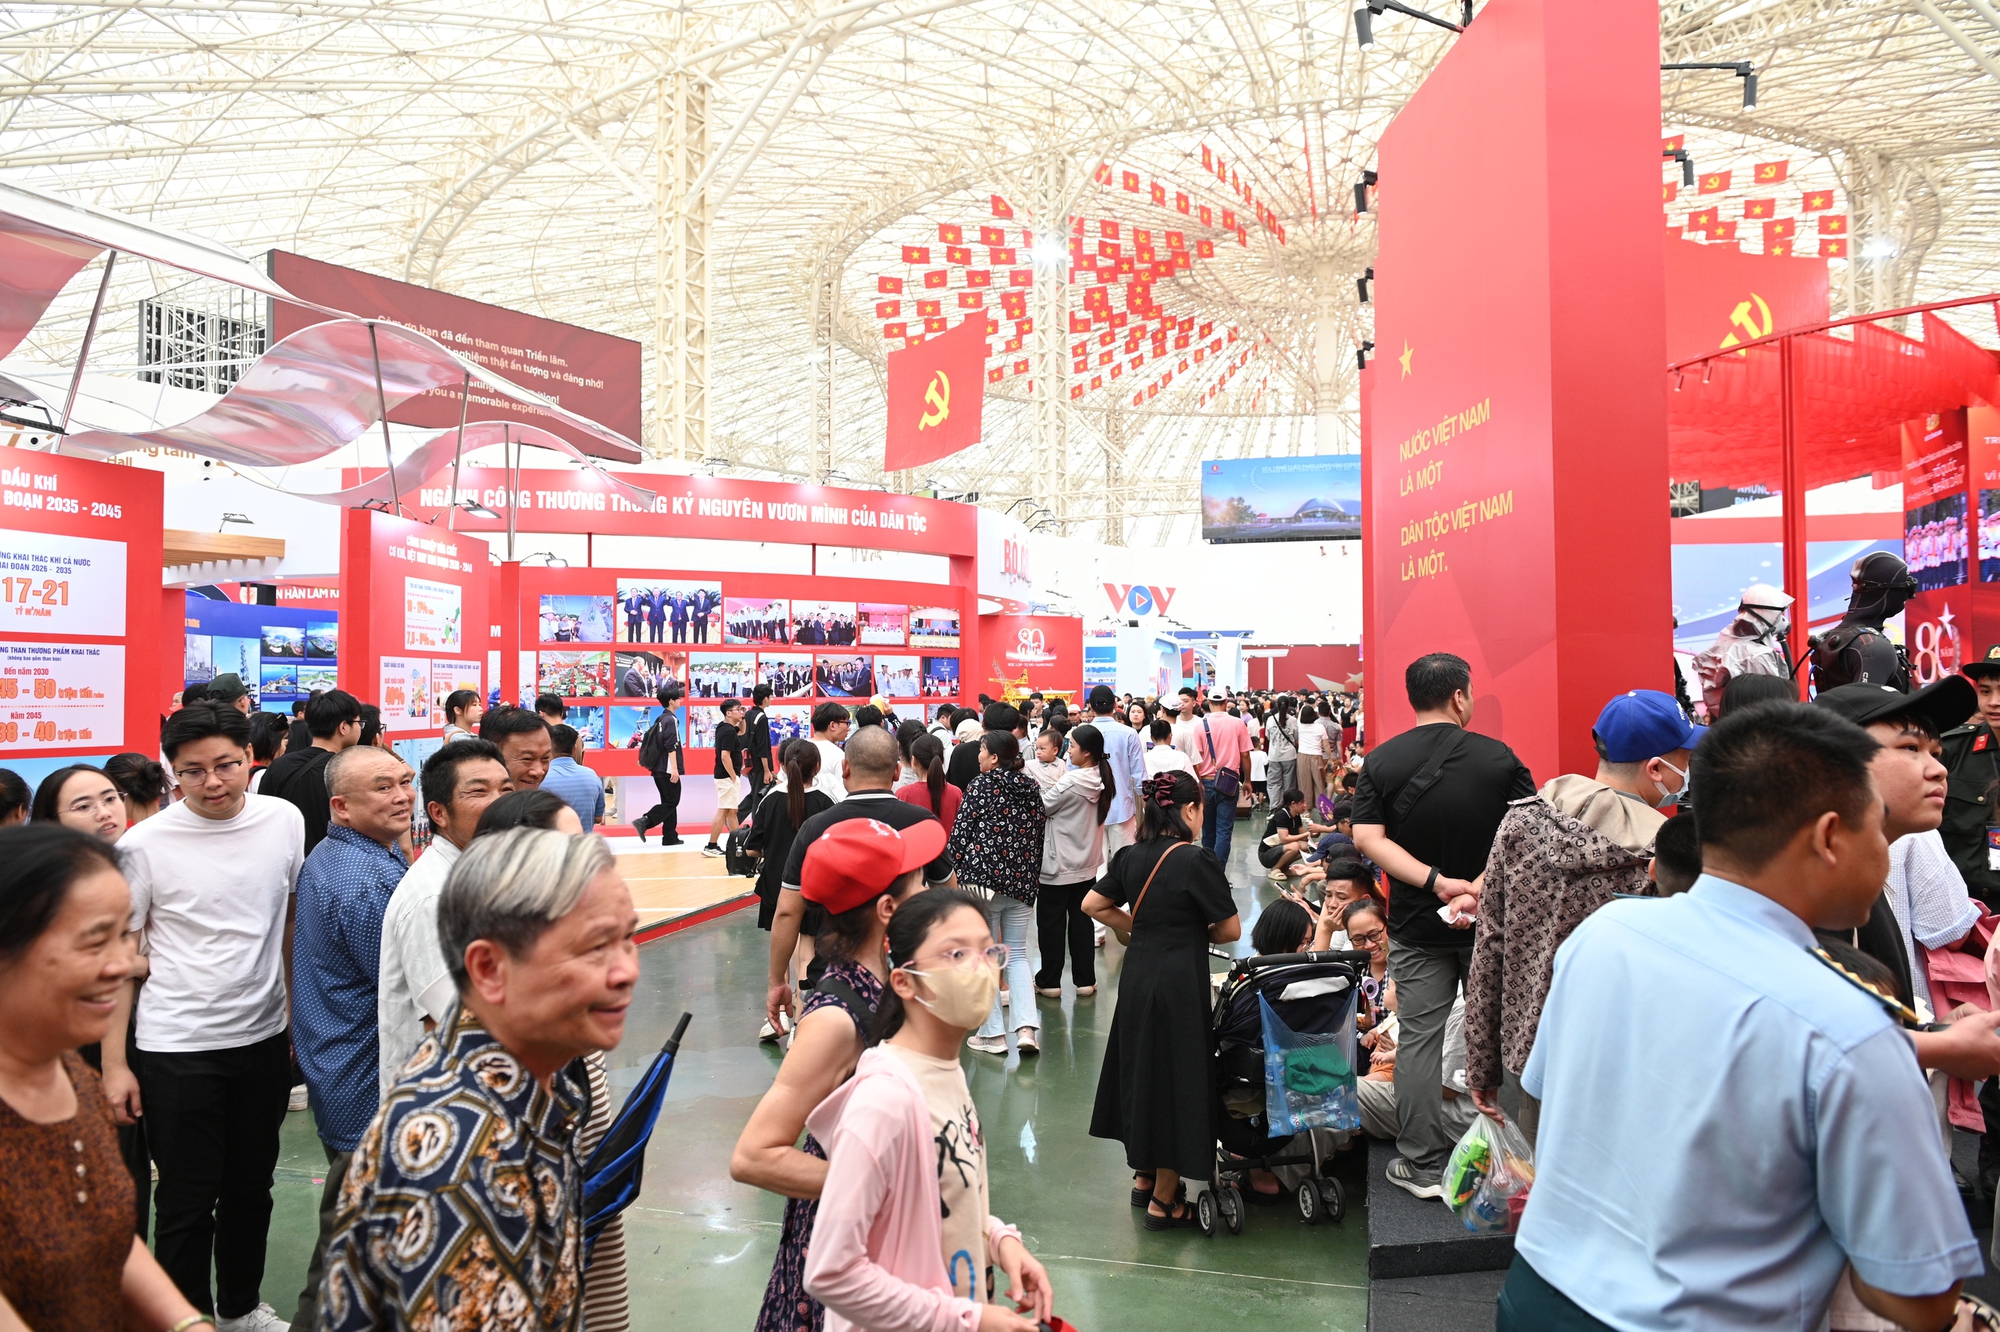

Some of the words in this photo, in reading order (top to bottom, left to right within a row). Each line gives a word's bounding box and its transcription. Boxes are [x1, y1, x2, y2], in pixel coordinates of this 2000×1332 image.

[441, 330, 453, 340] đã
[455, 333, 473, 345] đến
[475, 338, 499, 351] tham
[501, 345, 524, 358] quan
[525, 348, 548, 362] Triển
[549, 354, 568, 367] lãm.
[490, 357, 509, 369] thật
[523, 363, 549, 379] tượng
[551, 370, 562, 379] và
[563, 374, 584, 387] đáng
[428, 387, 448, 397] you
[449, 391, 455, 399] a
[1400, 429, 1430, 462] NƯỚC
[1432, 414, 1457, 447] VIỆT
[1459, 397, 1490, 433] NAM
[34, 474, 58, 491] KHÍ
[1400, 470, 1414, 497] LÀ
[1416, 460, 1443, 490] MỘT
[3, 490, 43, 511] ĐOẠN
[46, 496, 79, 514] 2035
[91, 502, 122, 519] 2045
[536, 489, 606, 512] THƯƠNG
[672, 491, 695, 515] KỶ
[698, 497, 763, 520] NGUYÊN
[768, 502, 808, 523] VƯƠN
[811, 500, 848, 525] MÌNH
[851, 504, 877, 528] CỦA
[880, 510, 905, 531] DÂN
[907, 512, 927, 535] TỘC
[1401, 519, 1423, 547] DÂN
[1425, 511, 1449, 542] TỘC
[1451, 500, 1478, 533] VIỆT
[1479, 490, 1513, 523] NAM
[10, 562, 30, 572] ĐOẠN
[31, 564, 48, 573] 2026
[56, 566, 72, 574] 2035
[13, 552, 30, 561] KHAI
[31, 554, 48, 563] THÁC
[1004, 533, 1018, 583] BỘ
[1401, 555, 1416, 582] LÀ
[1417, 549, 1448, 580] MỘT.
[2, 576, 69, 605] 17-21
[285, 586, 306, 599] HÀN
[307, 588, 329, 599] LAM
[1102, 583, 1177, 616] VOV
[11, 646, 27, 654] THAN
[18, 667, 32, 675] năm
[33, 668, 49, 676] 2030
[34, 678, 56, 699] 50
[58, 687, 78, 700] triệu
[10, 711, 25, 720] Năm
[26, 711, 42, 720] 2045
[34, 721, 56, 742] 40
[58, 728, 78, 742] triệu
[79, 727, 92, 740] tấn
